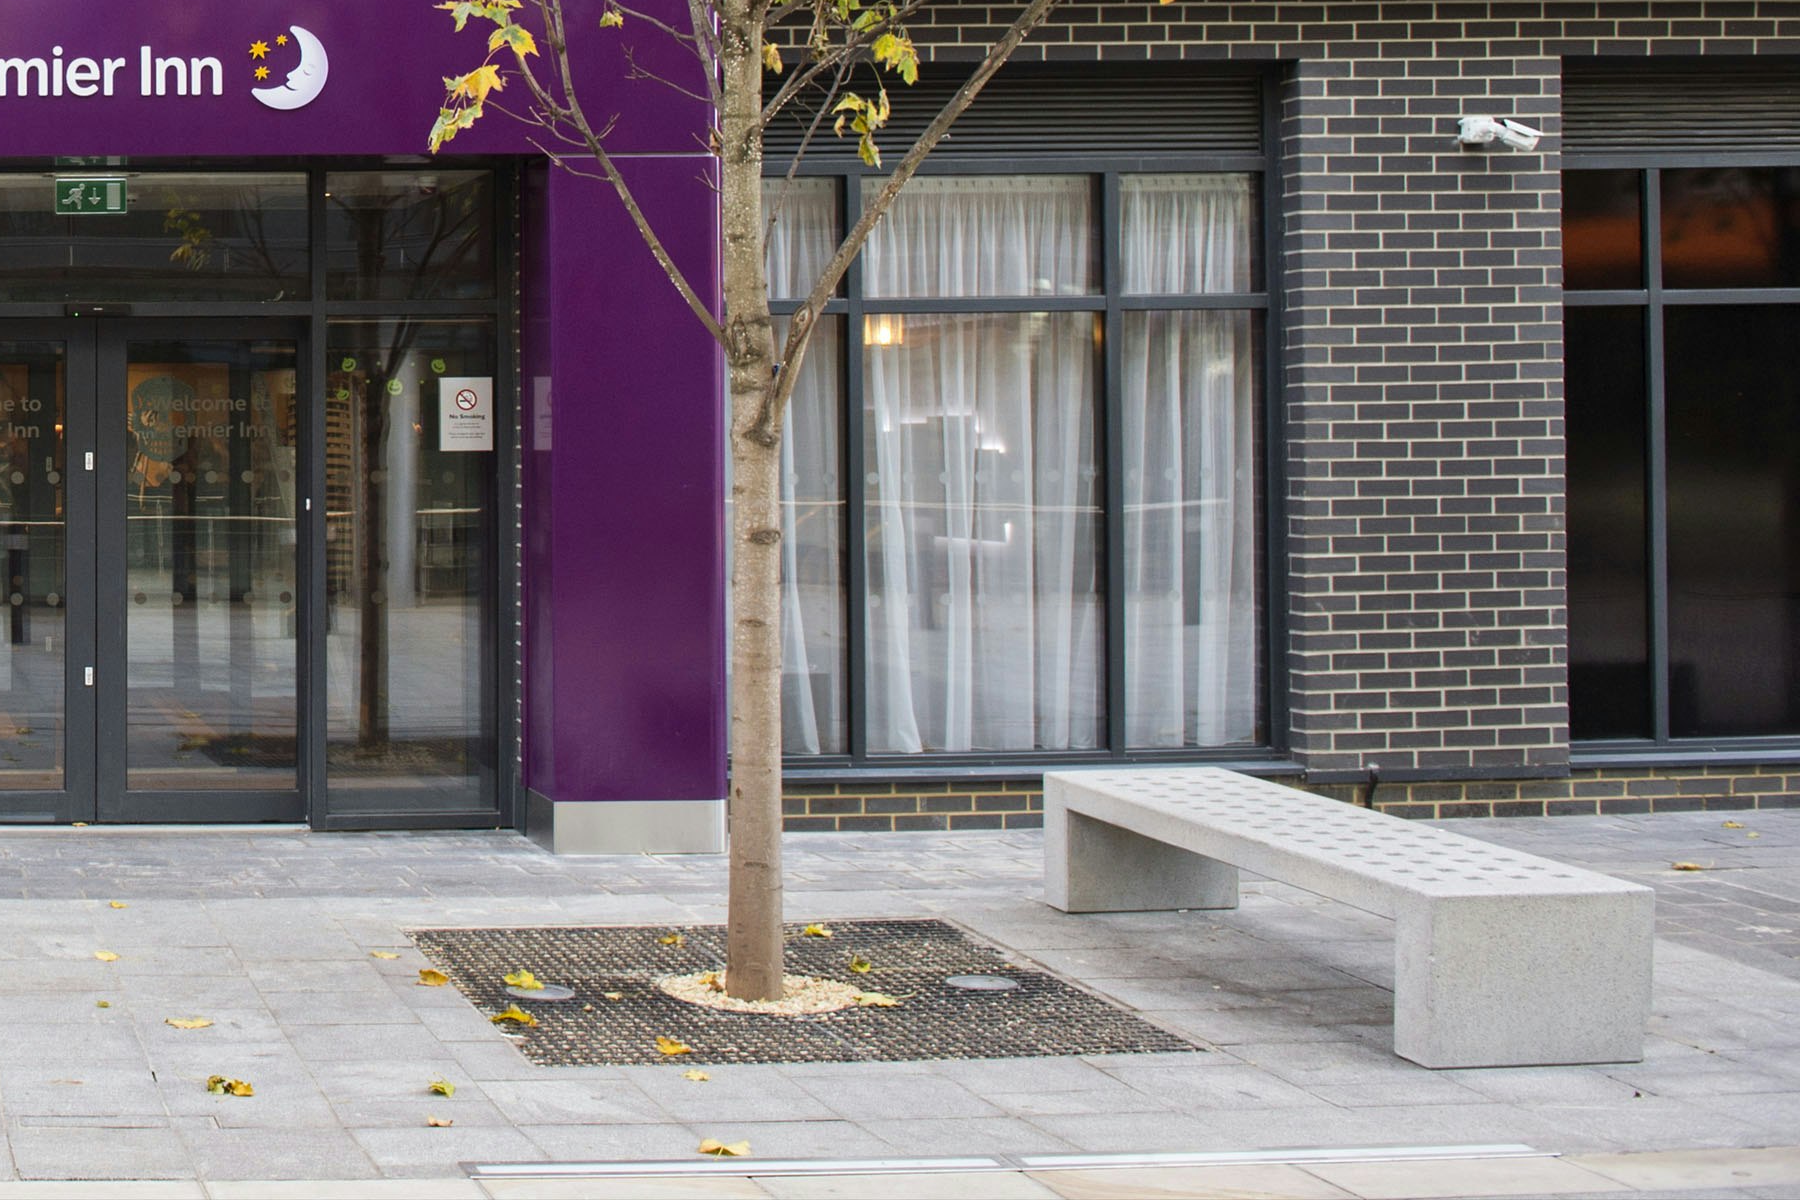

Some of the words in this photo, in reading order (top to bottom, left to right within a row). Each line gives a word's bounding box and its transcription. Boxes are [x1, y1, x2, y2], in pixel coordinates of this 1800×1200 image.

[141, 45, 223, 97] Inn
[20, 396, 42, 412] to
[151, 394, 247, 412] Welcome
[460, 413, 486, 421] Smoking
[7, 422, 41, 438] Inn
[162, 422, 234, 438] remier
